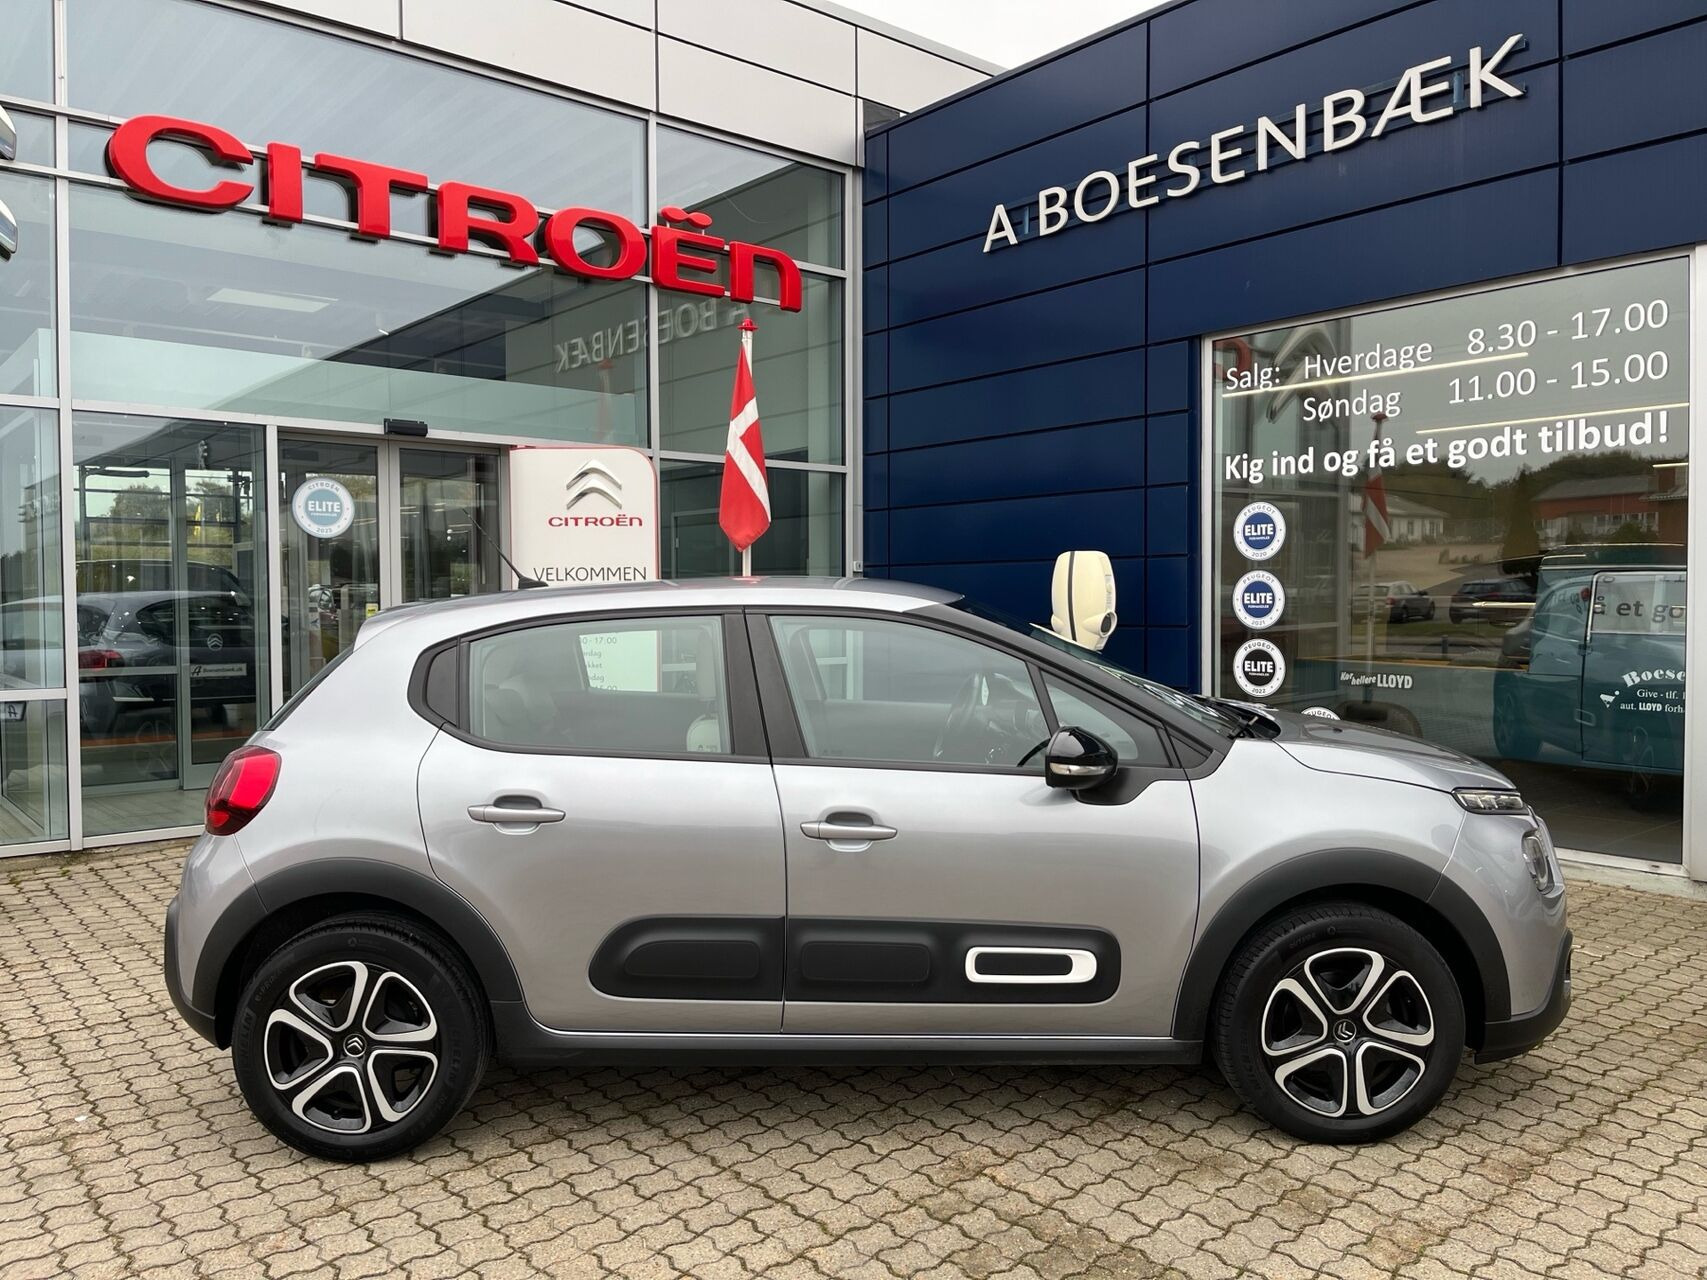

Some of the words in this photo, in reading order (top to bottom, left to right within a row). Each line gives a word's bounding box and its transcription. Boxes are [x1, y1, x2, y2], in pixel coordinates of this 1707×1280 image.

[983, 203, 1018, 253] A
[1039, 33, 1525, 237] BOESENBÆK
[1226, 362, 1280, 390] Salg:
[1304, 342, 1432, 379] Hverdage
[1467, 320, 1537, 354] 8.30
[1571, 299, 1669, 340] 17.00
[1303, 389, 1401, 422] Søndag
[1449, 368, 1536, 404] 11.00
[1570, 351, 1669, 389] 15.00
[1225, 453, 1264, 484] Kig
[1272, 446, 1314, 476] ind
[1323, 450, 1359, 476] og
[1367, 437, 1396, 468] få
[1406, 438, 1438, 465] et
[1447, 426, 1527, 468] godt
[1538, 410, 1668, 453] tilbud!
[308, 500, 341, 513] ELITE
[1243, 505, 1276, 517] PEUGEOT
[1244, 523, 1274, 537] ELITE
[533, 566, 647, 581] VELKOMMEN
[1242, 573, 1275, 585] PEUGEOT
[1243, 592, 1273, 605] ELITE
[1243, 641, 1275, 652] PEUGEOT
[1244, 660, 1274, 673] ELITE
[1377, 673, 1413, 689] LLOYD
[1636, 688, 1658, 698] Give
[1620, 702, 1637, 711] aut.
[1639, 702, 1663, 712] LLOYD
